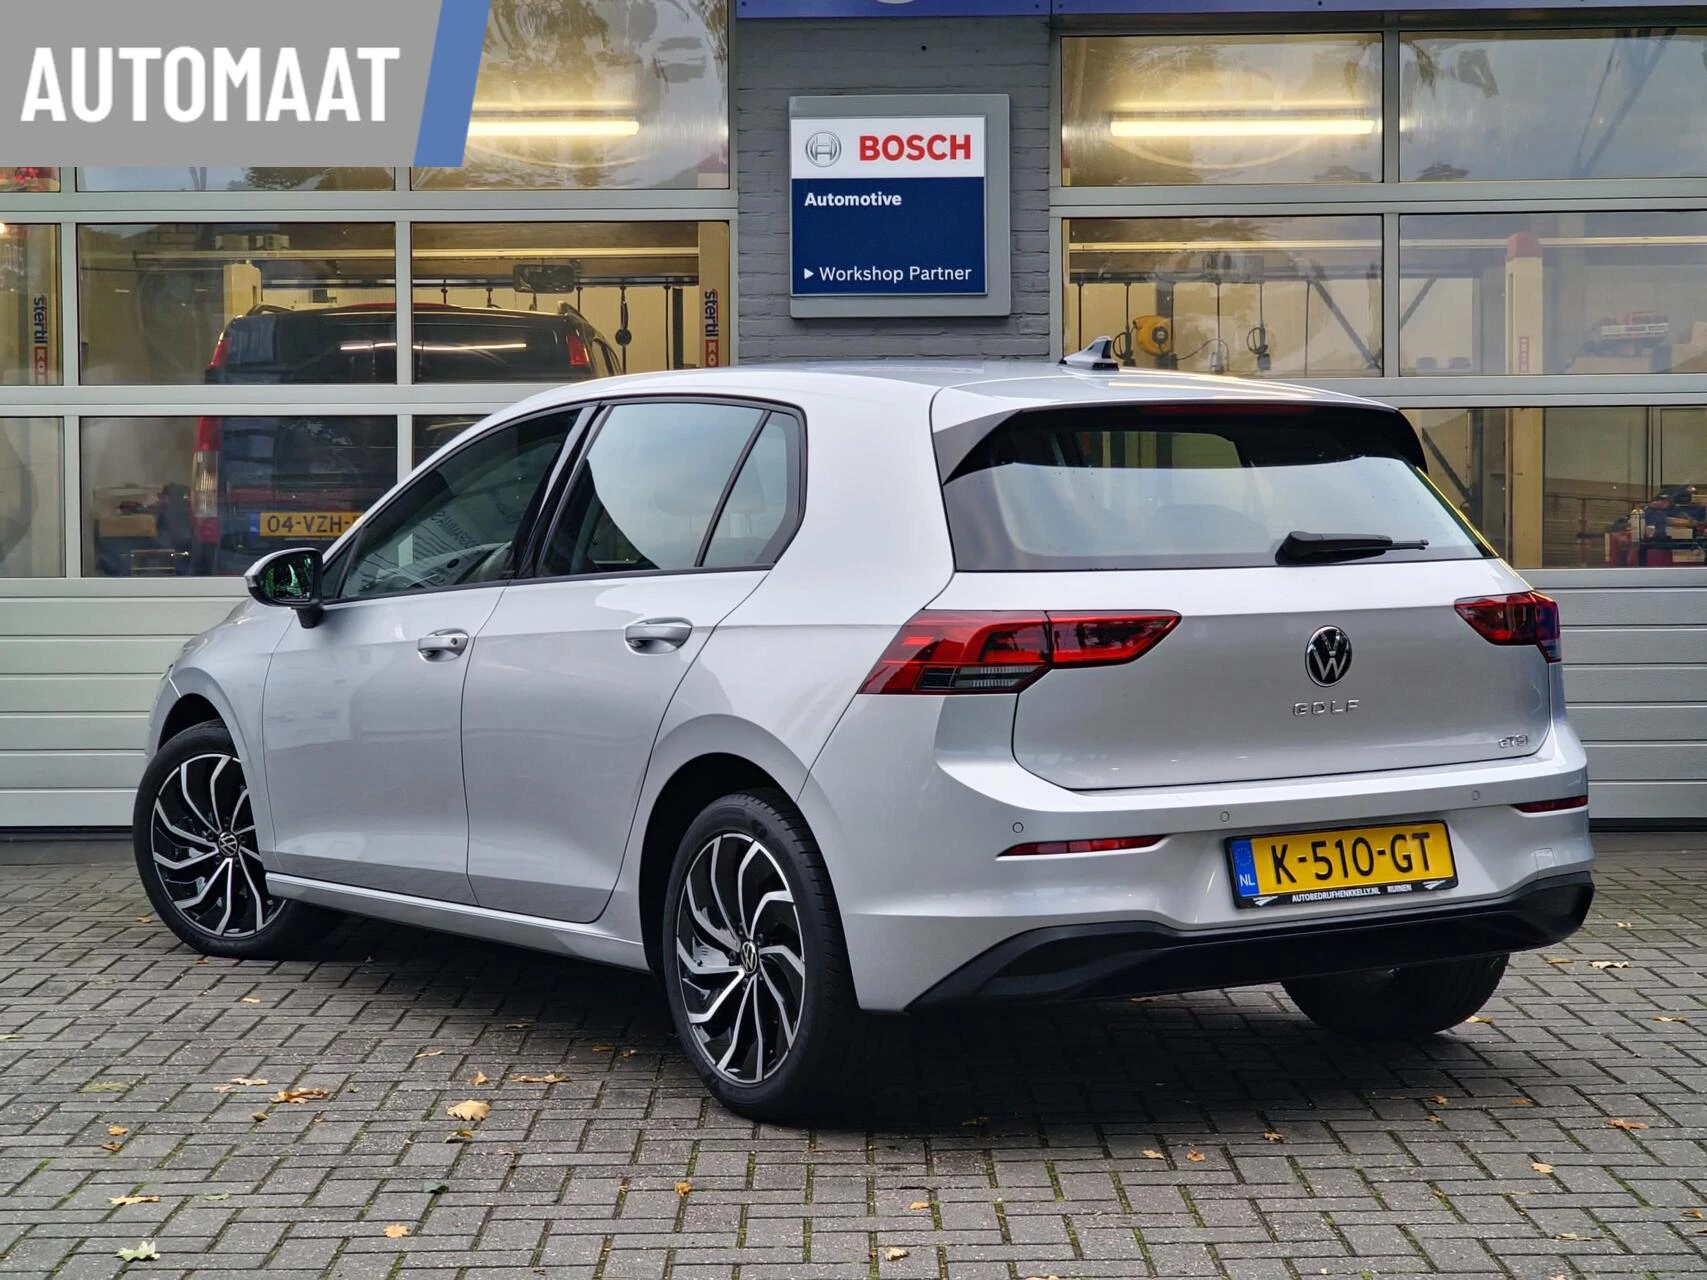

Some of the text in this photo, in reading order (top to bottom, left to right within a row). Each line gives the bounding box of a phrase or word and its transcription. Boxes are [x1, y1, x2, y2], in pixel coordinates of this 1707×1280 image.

[859, 134, 971, 162] BOSCH
[804, 191, 902, 207] Automotive
[819, 265, 972, 284] Workshop Partner
[704, 290, 719, 337] stertil
[1293, 699, 1359, 716] GOLF
[1239, 831, 1431, 887] NL K-510-GT
